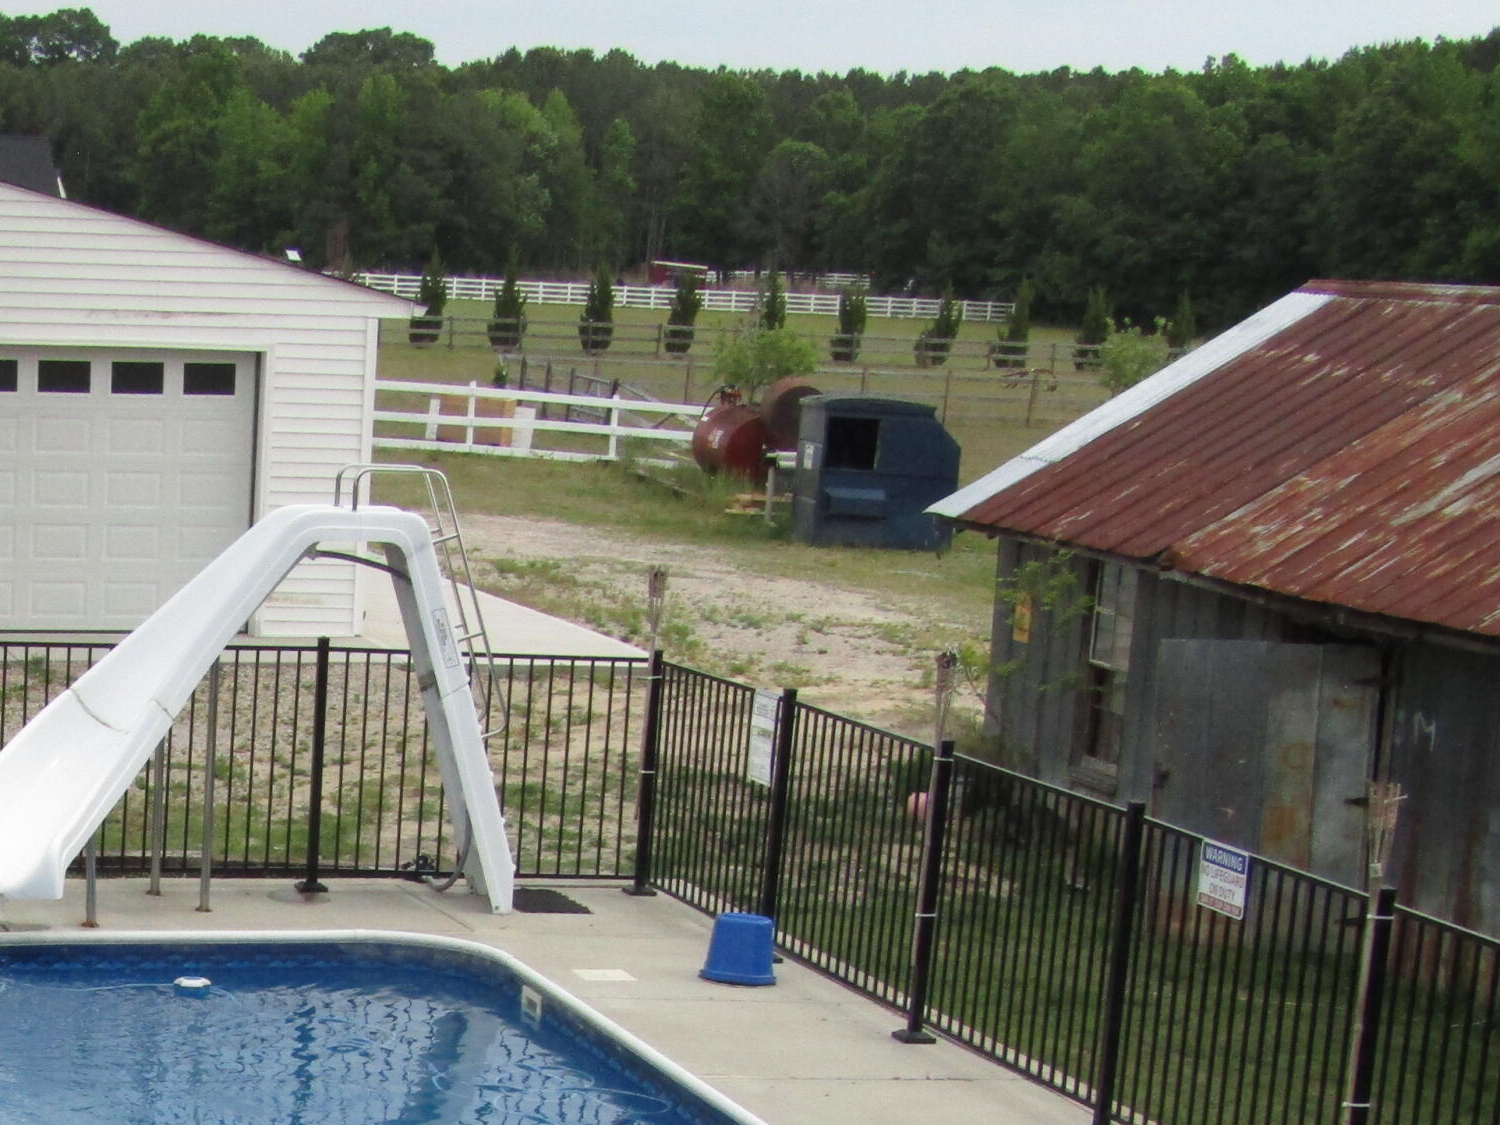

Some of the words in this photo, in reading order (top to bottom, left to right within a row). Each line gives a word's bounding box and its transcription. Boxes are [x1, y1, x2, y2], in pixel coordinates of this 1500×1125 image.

[1205, 846, 1243, 872] WARNING
[1211, 867, 1245, 889] LIFEGUARD
[1219, 885, 1236, 901] DUTY
